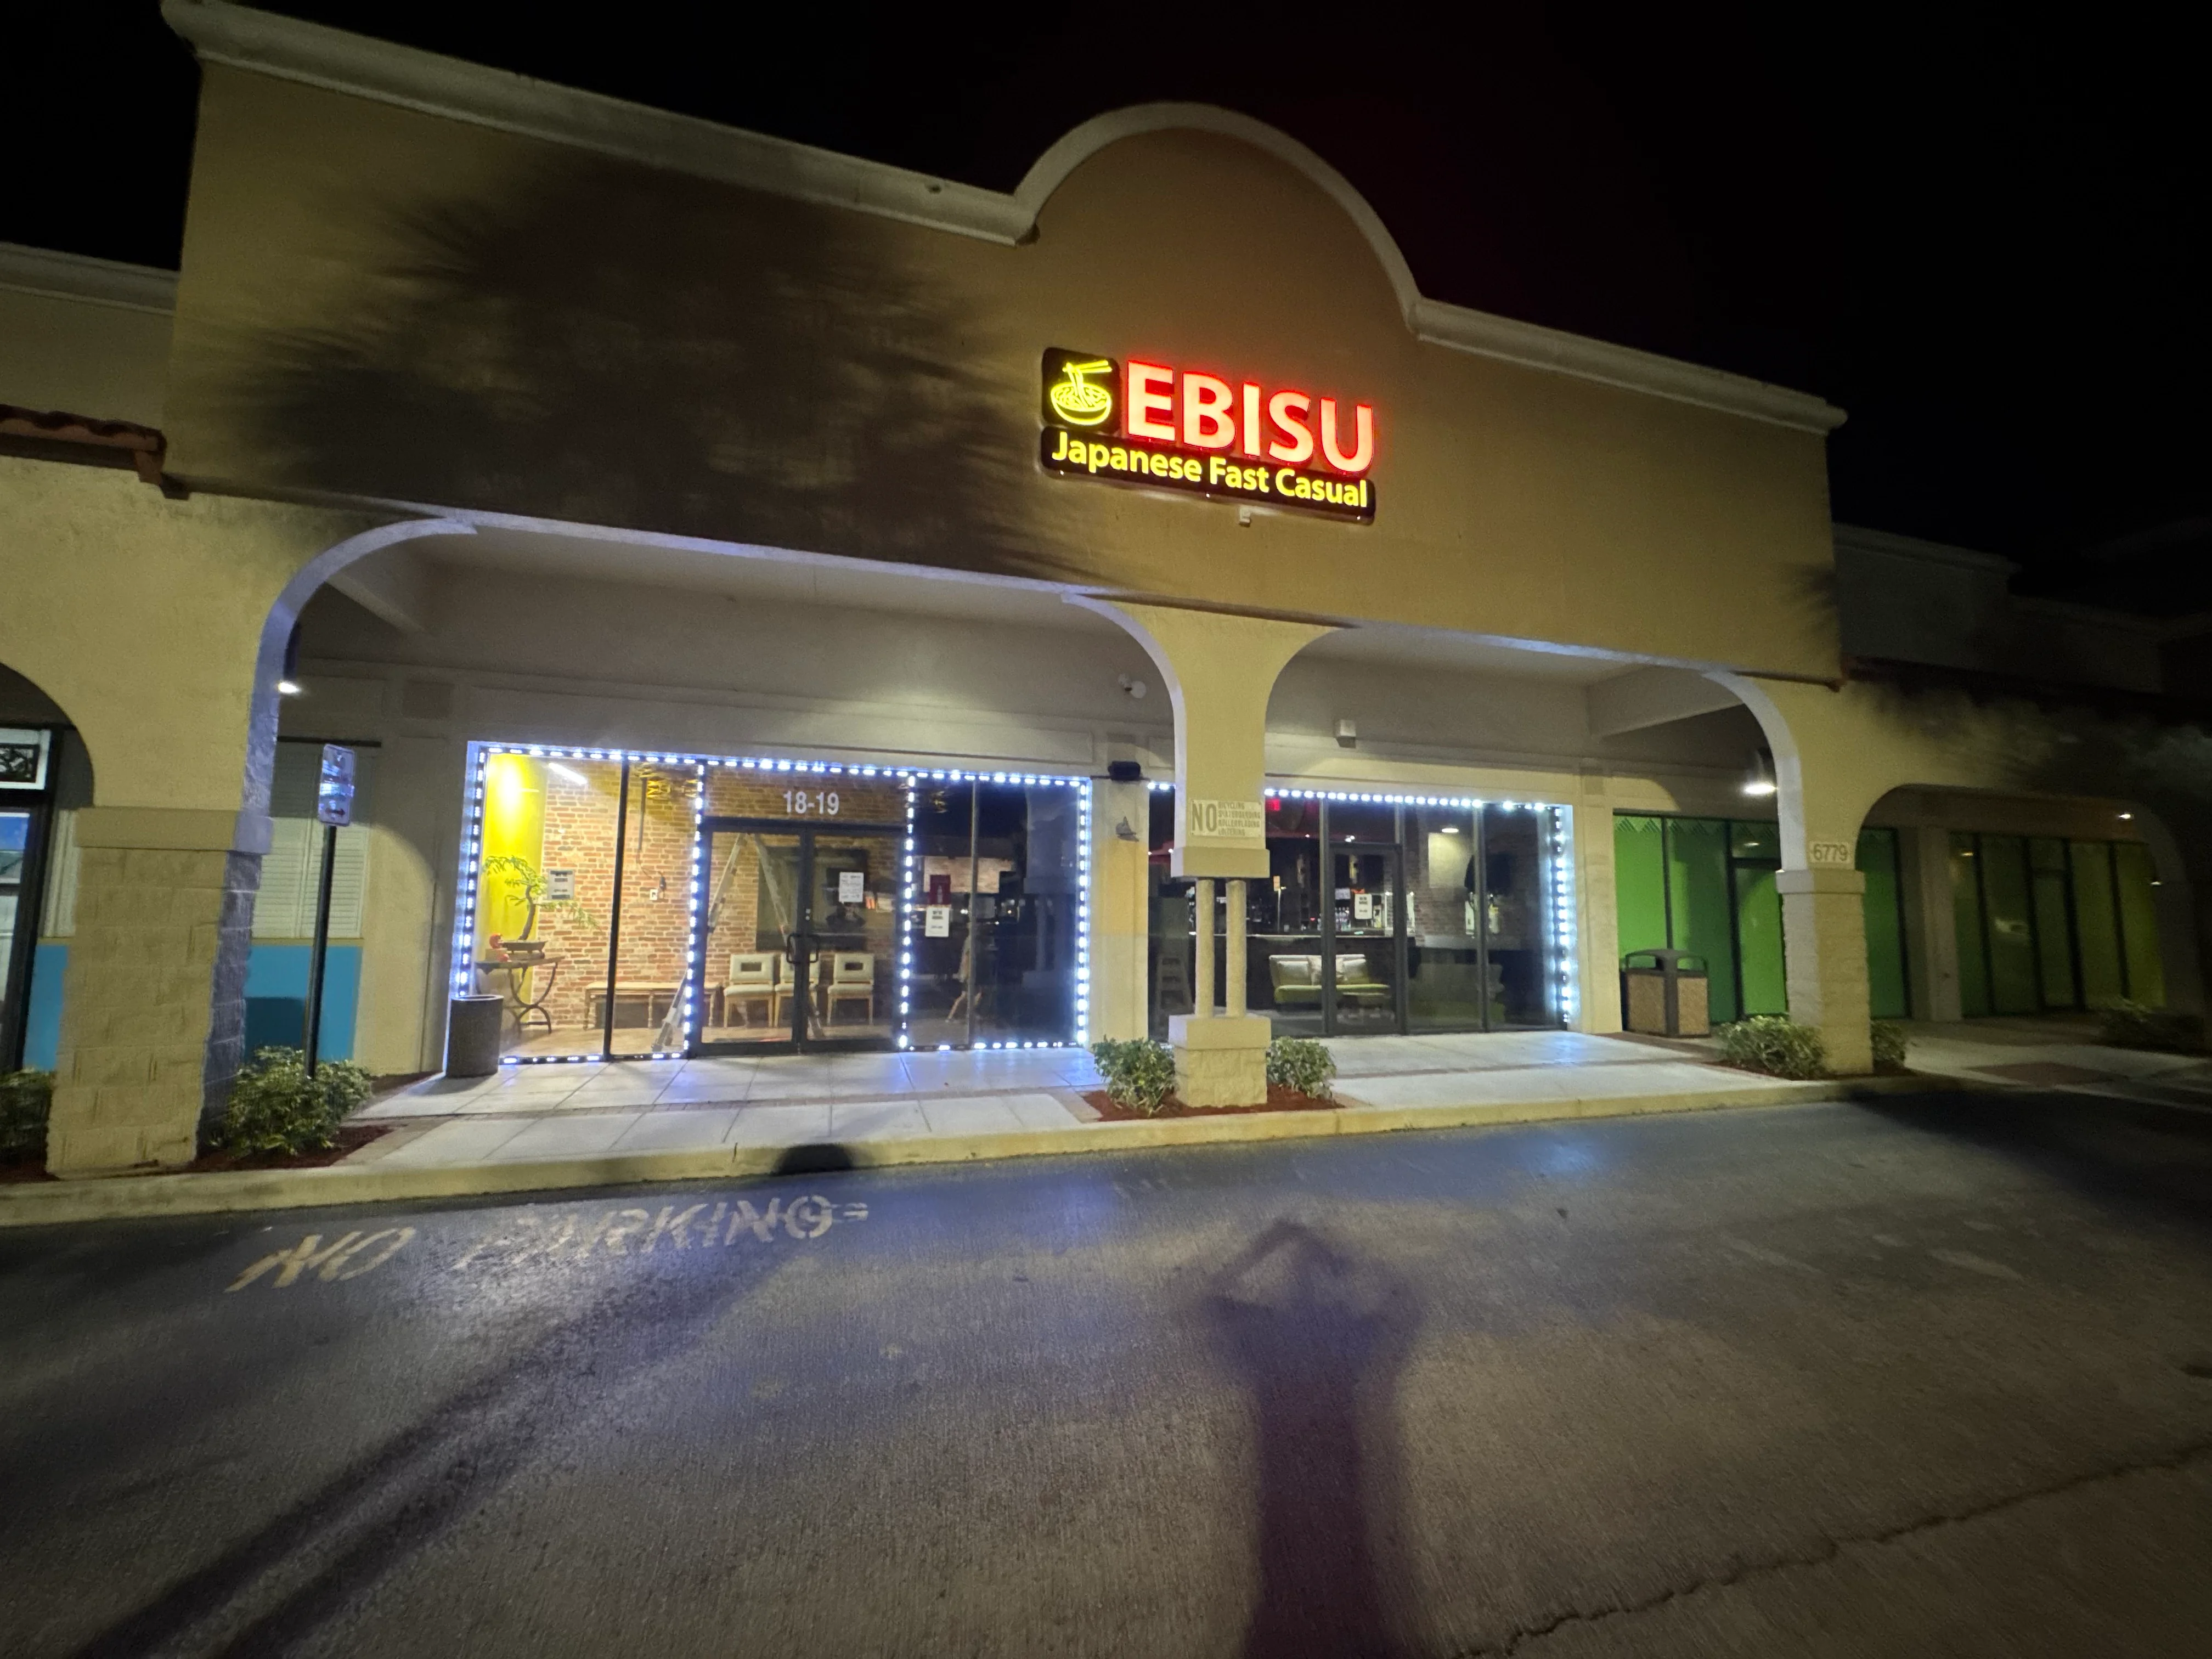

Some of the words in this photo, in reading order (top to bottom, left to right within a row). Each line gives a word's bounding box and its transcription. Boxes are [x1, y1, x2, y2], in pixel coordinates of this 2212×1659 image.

[1127, 360, 1374, 473] EBISU
[1051, 431, 1201, 482] Japanese
[1209, 455, 1269, 492] Fast
[1276, 470, 1368, 507] Casual
[783, 791, 839, 815] 18-19
[1192, 803, 1217, 832] NO
[1813, 843, 1848, 861] 6779
[224, 1226, 417, 1293] NO
